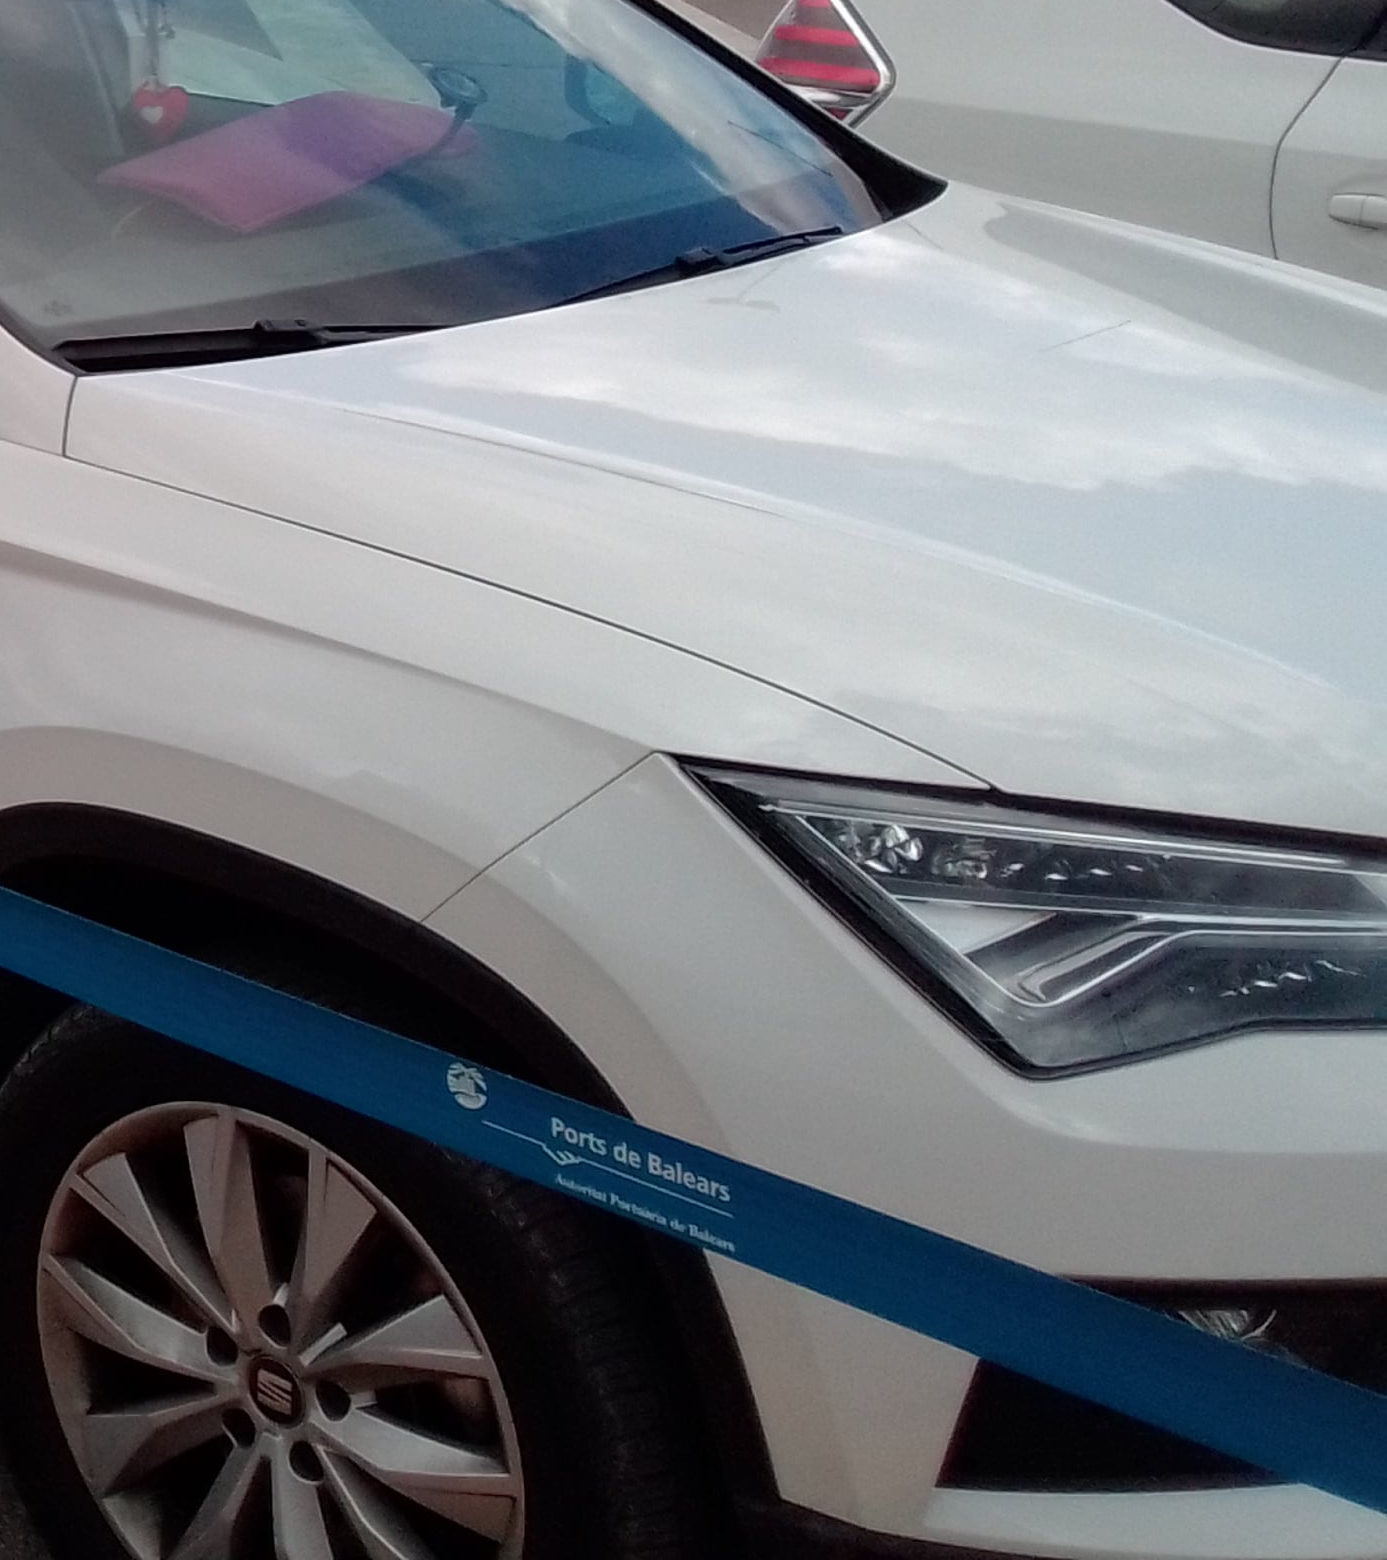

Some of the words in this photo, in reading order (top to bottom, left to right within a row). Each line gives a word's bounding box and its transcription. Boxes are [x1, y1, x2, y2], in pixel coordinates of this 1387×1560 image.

[551, 1116, 607, 1156] Ports
[613, 1142, 642, 1169] de
[647, 1152, 732, 1203] Balears
[670, 1218, 686, 1233] de
[688, 1223, 736, 1253] Balears
